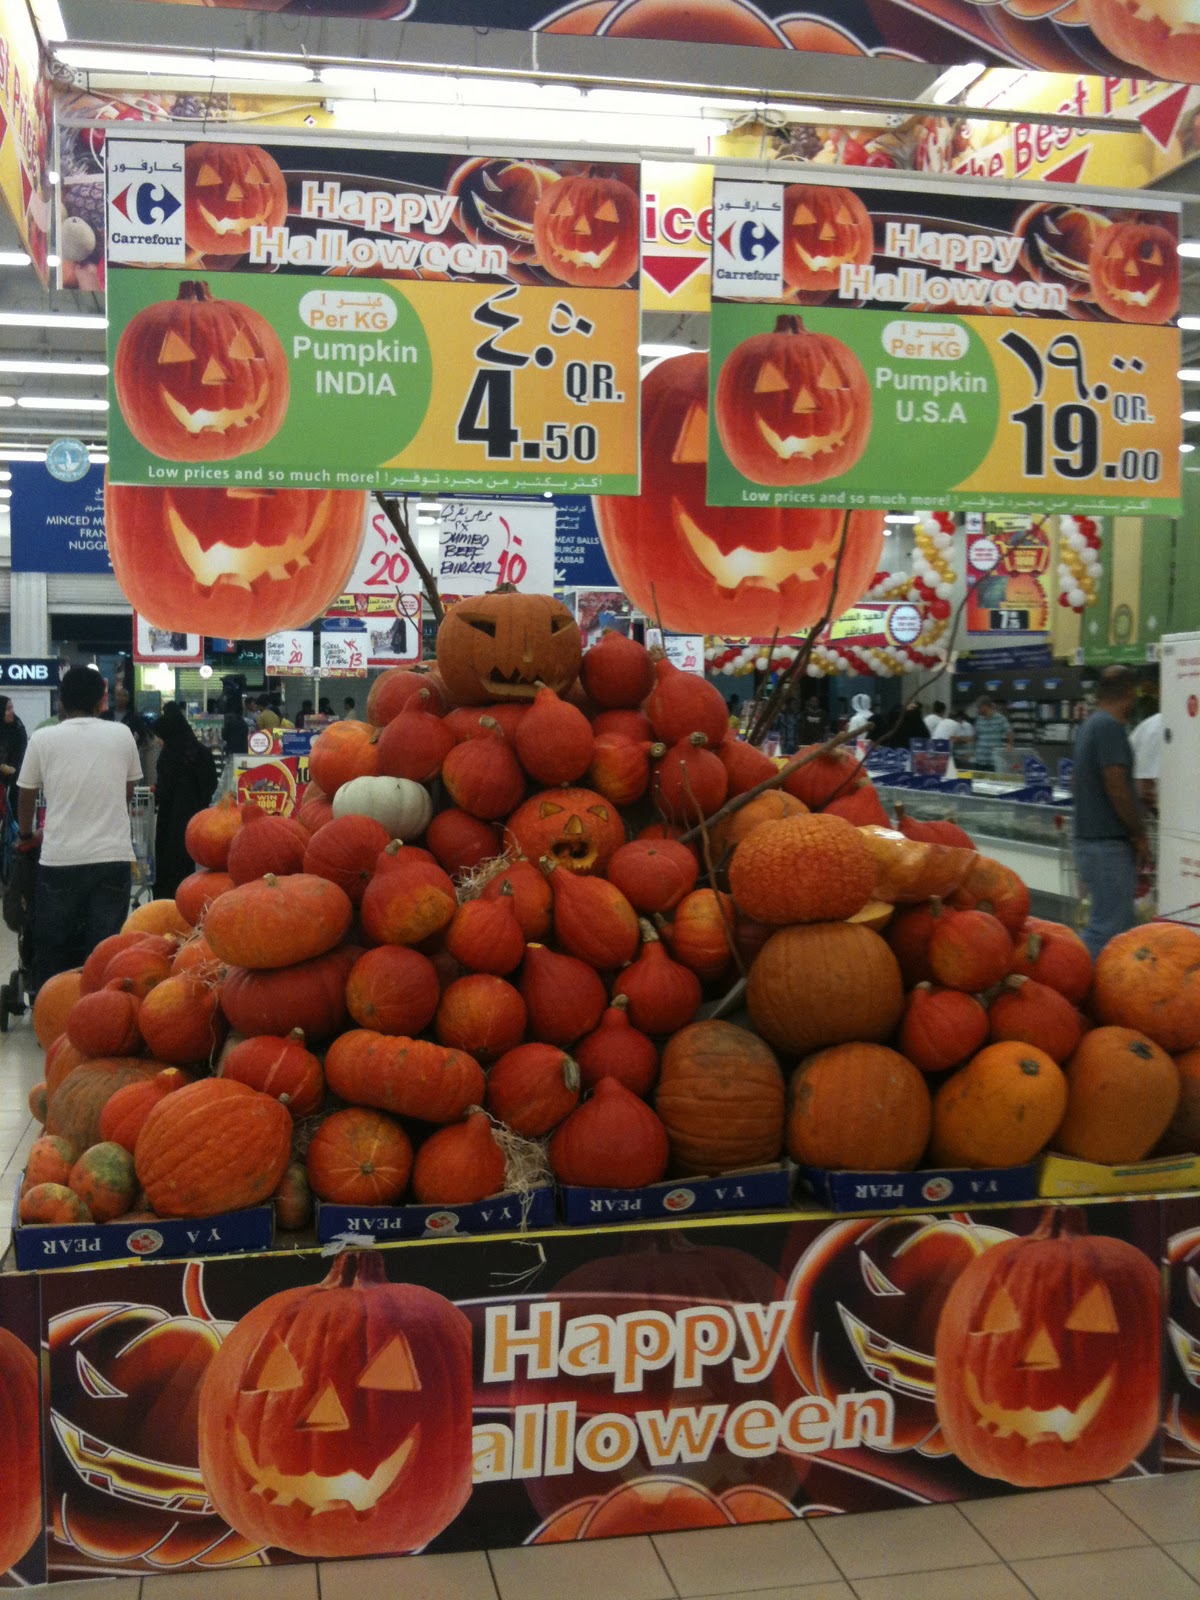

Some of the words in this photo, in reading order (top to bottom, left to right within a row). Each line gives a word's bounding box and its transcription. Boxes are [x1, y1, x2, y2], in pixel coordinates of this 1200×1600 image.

[112, 158, 182, 173] كارفور
[301, 180, 459, 235] Happy
[718, 199, 781, 212] كارفور
[111, 233, 182, 246] Carrefour
[885, 222, 1025, 273] Happy
[249, 226, 510, 274] Halloween
[716, 269, 780, 281] Carrefour
[839, 263, 1069, 311] Halloween
[310, 309, 348, 328] Per
[354, 311, 388, 329] KG
[293, 335, 418, 367] Pumpkin
[891, 338, 924, 356] Per
[930, 341, 961, 357] KG
[316, 370, 397, 397] INDIA
[875, 367, 988, 397] Pumpkin
[896, 401, 967, 424] U.S.A
[148, 466, 179, 479] Low
[184, 466, 230, 481] prices
[234, 467, 264, 480] and
[268, 471, 285, 481] so
[290, 469, 331, 482] much
[336, 470, 380, 483] more!
[741, 490, 770, 502] Low
[774, 491, 815, 506] prices
[819, 491, 846, 503] and
[849, 494, 865, 504] so
[868, 493, 907, 505] much
[47, 517, 89, 525] MINCED
[439, 532, 489, 547] JUMBO
[445, 545, 484, 560] BEEF
[363, 551, 410, 586] 20
[497, 550, 527, 587] 10
[8, 664, 48, 679] QNB
[855, 1184, 904, 1198] PEAR
[590, 1199, 642, 1212] PEAR
[347, 1217, 402, 1231] PEAR
[43, 1238, 101, 1254] PEAR
[483, 1300, 793, 1393] Happy
